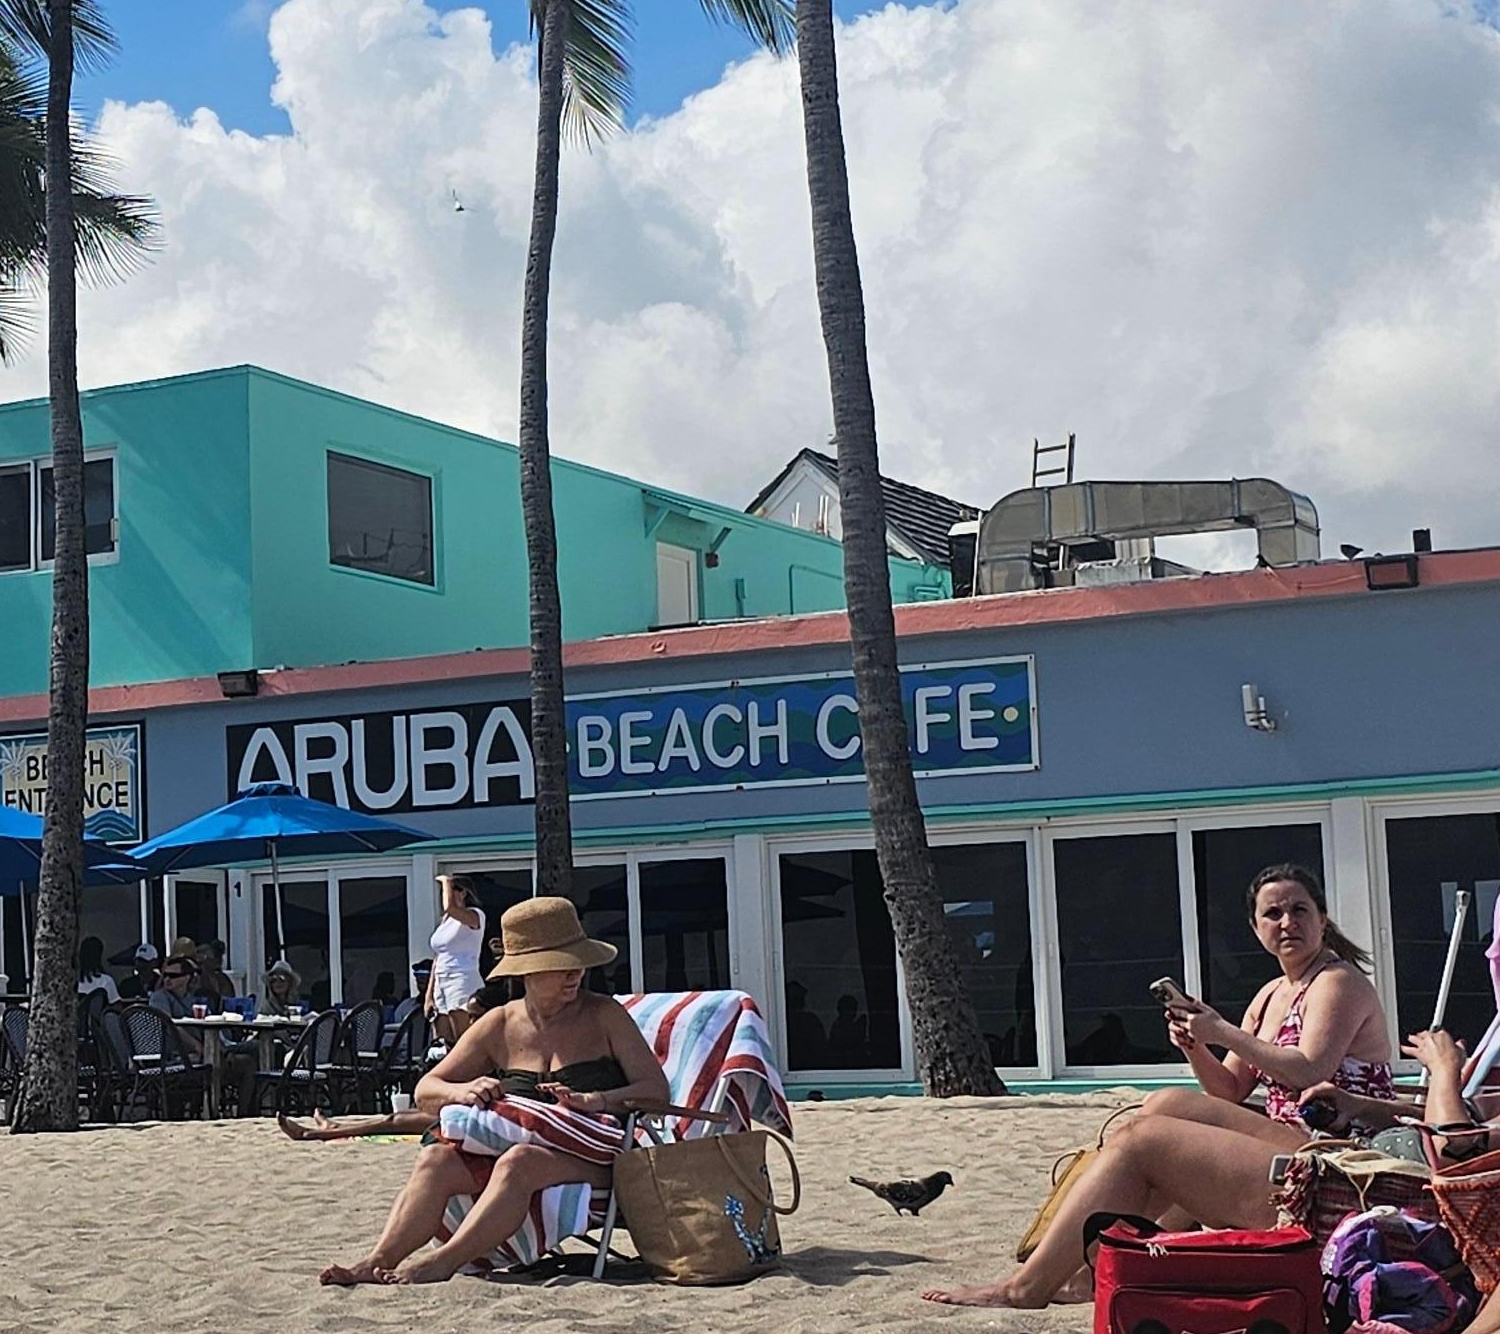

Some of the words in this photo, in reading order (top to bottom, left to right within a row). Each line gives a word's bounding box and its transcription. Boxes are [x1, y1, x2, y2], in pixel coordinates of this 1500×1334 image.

[237, 705, 536, 811] ARUBA
[576, 697, 790, 779] BEACH
[815, 681, 1000, 760] CFE
[4, 780, 129, 813] ENTNCE
[234, 881, 242, 898] 1
